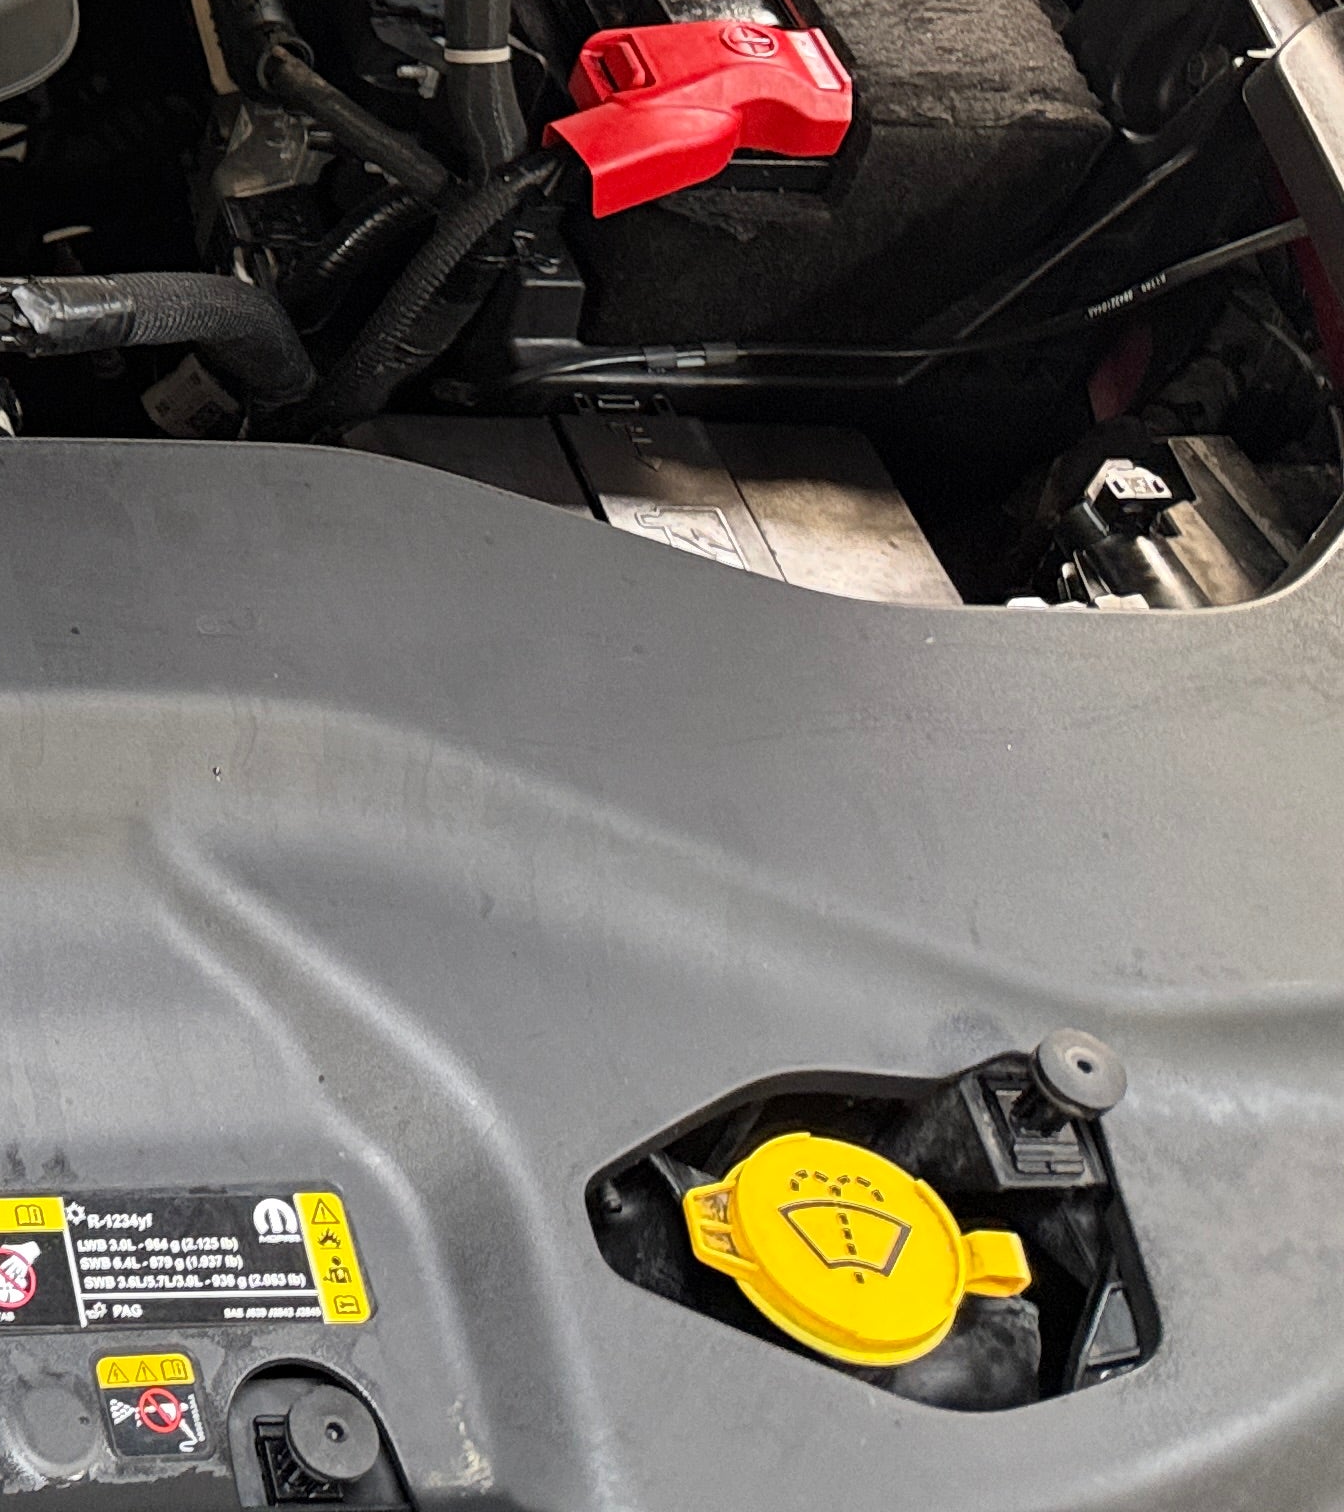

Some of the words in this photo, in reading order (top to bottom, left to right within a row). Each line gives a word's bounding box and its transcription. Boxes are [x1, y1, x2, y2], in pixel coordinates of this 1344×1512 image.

[86, 1213, 154, 1232] R-1234yf
[76, 1238, 108, 1253] LWB
[170, 1239, 180, 1253] g
[181, 1237, 220, 1253] (2.125
[220, 1237, 239, 1252] lb)
[79, 1256, 111, 1270] SWB
[174, 1257, 185, 1271] g
[224, 1255, 244, 1271] lb)
[84, 1275, 116, 1290] SWB
[236, 1276, 247, 1290] g
[287, 1273, 307, 1288] lb)
[112, 1304, 144, 1319] PAG
